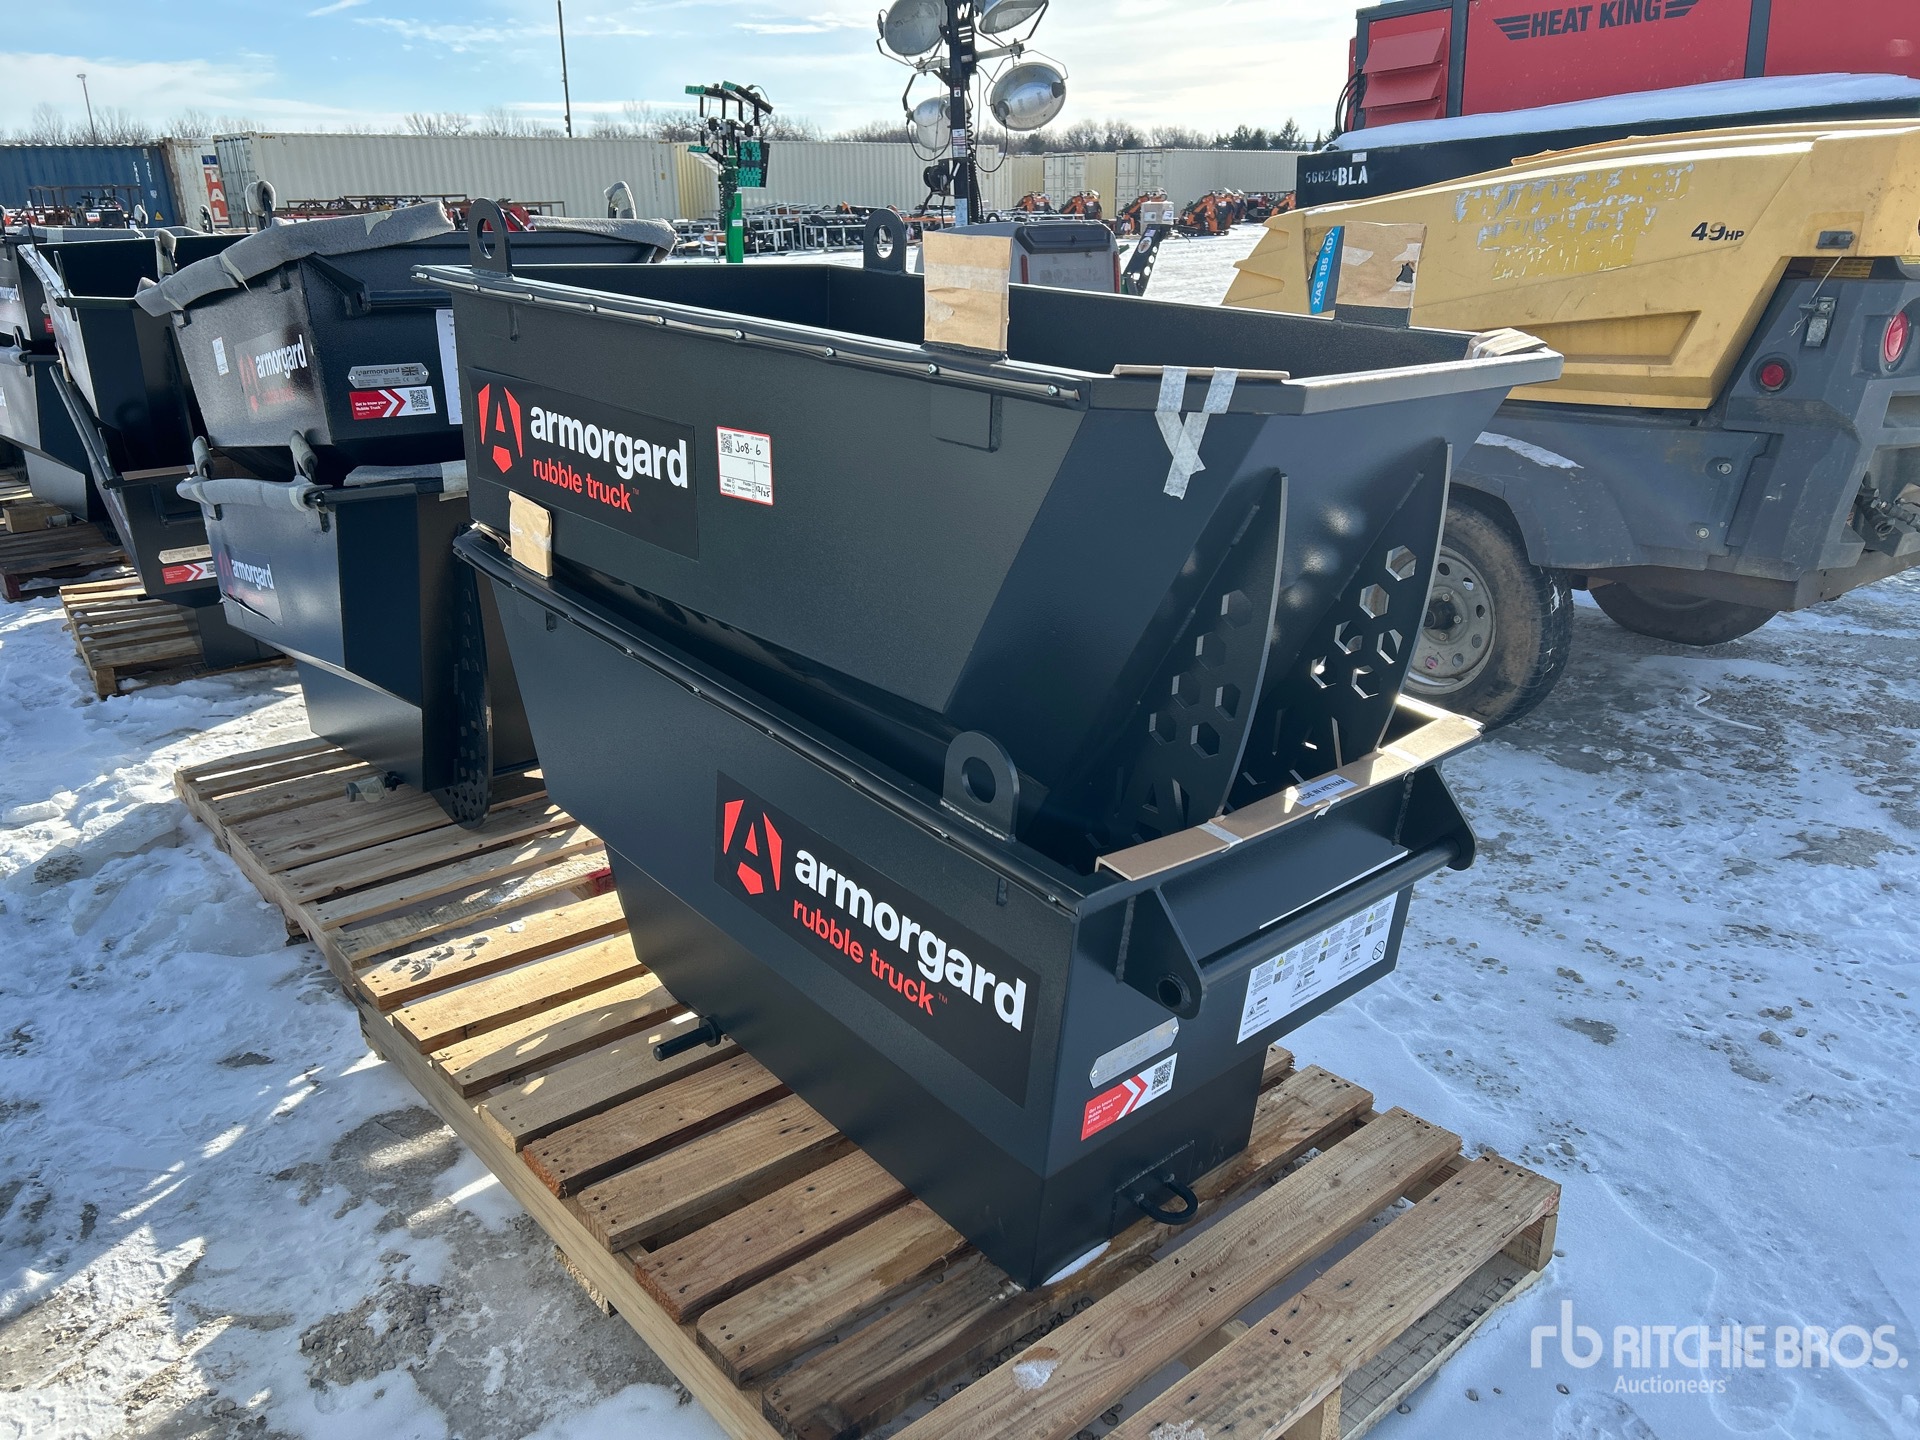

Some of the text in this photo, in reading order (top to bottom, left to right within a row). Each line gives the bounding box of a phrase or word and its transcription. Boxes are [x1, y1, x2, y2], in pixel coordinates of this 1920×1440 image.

[1531, 0, 1661, 38] HEAT KING
[1313, 281, 1324, 305] XAS
[1319, 257, 1329, 277] 185
[255, 334, 308, 379] armorgard
[362, 367, 400, 375] armorgard
[530, 405, 689, 489] armorgard
[532, 457, 583, 495] rubble
[231, 559, 275, 591] armorgard
[1320, 779, 1348, 792] VIETNAM
[794, 898, 864, 964] rubble
[794, 849, 1027, 1032] armorgard
